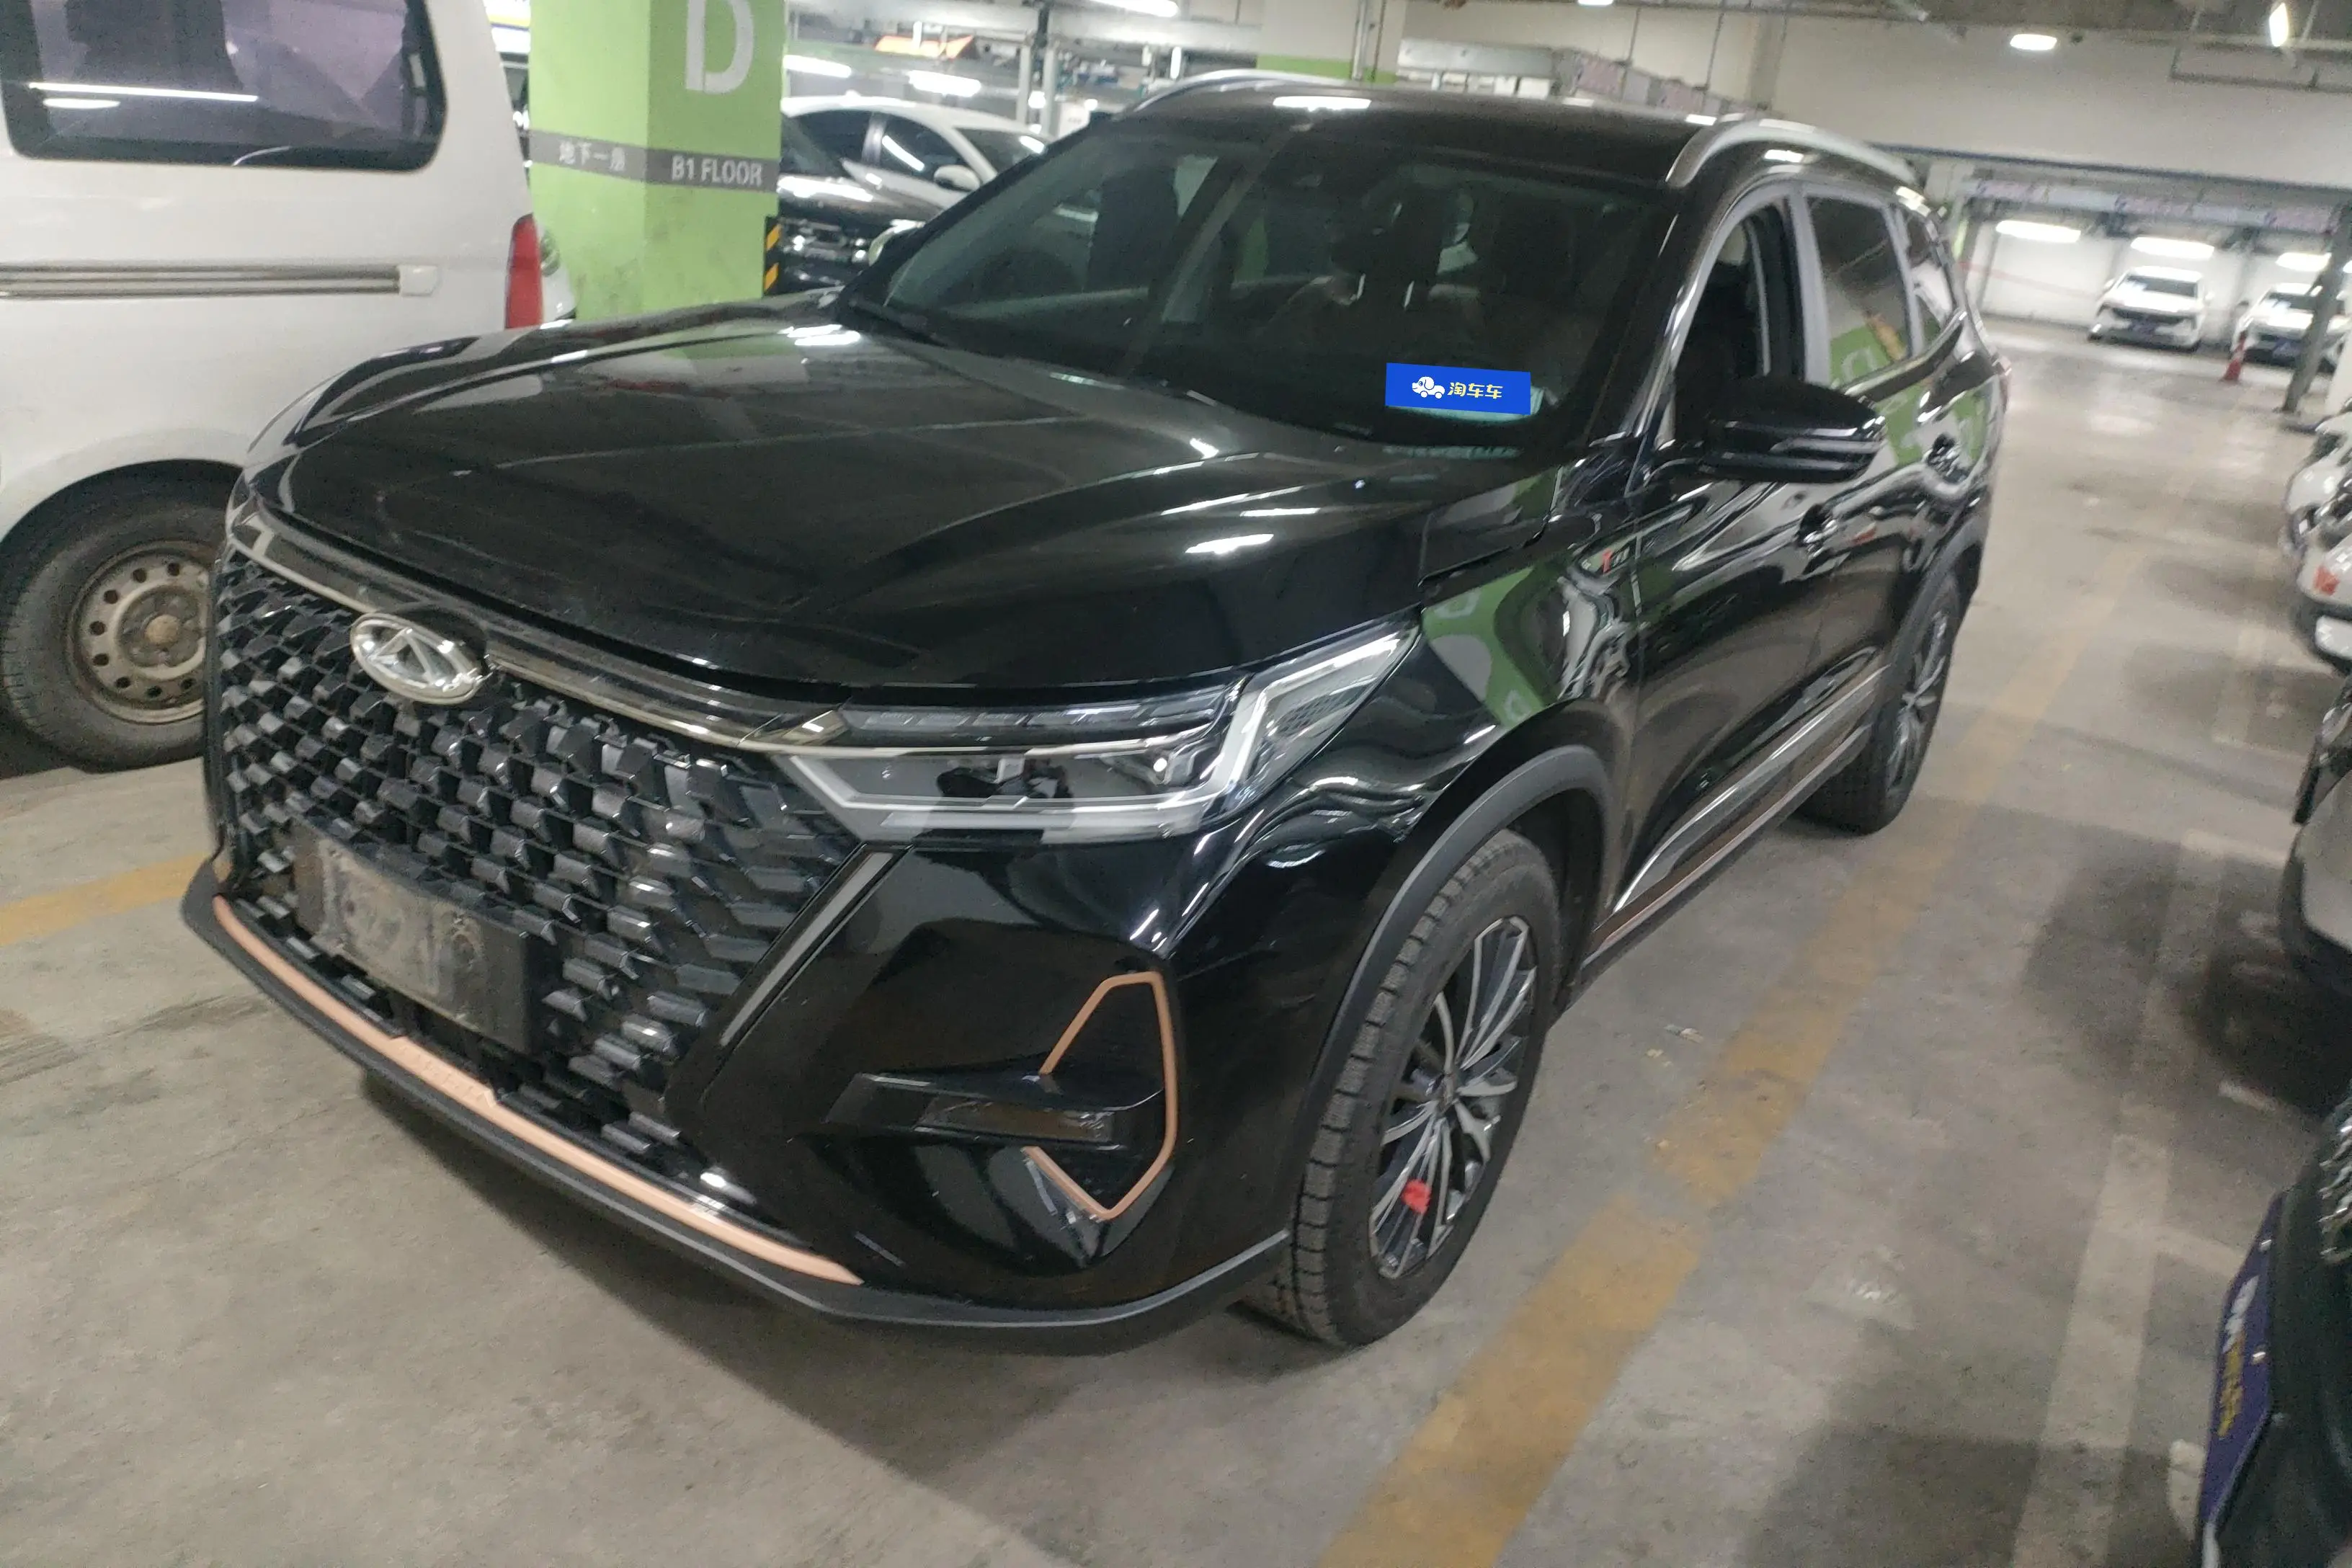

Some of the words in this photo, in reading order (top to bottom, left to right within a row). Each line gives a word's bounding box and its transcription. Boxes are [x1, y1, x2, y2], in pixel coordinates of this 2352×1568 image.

[686, 0, 754, 94] D
[671, 156, 695, 181] B1
[701, 159, 762, 187] FLOOR
